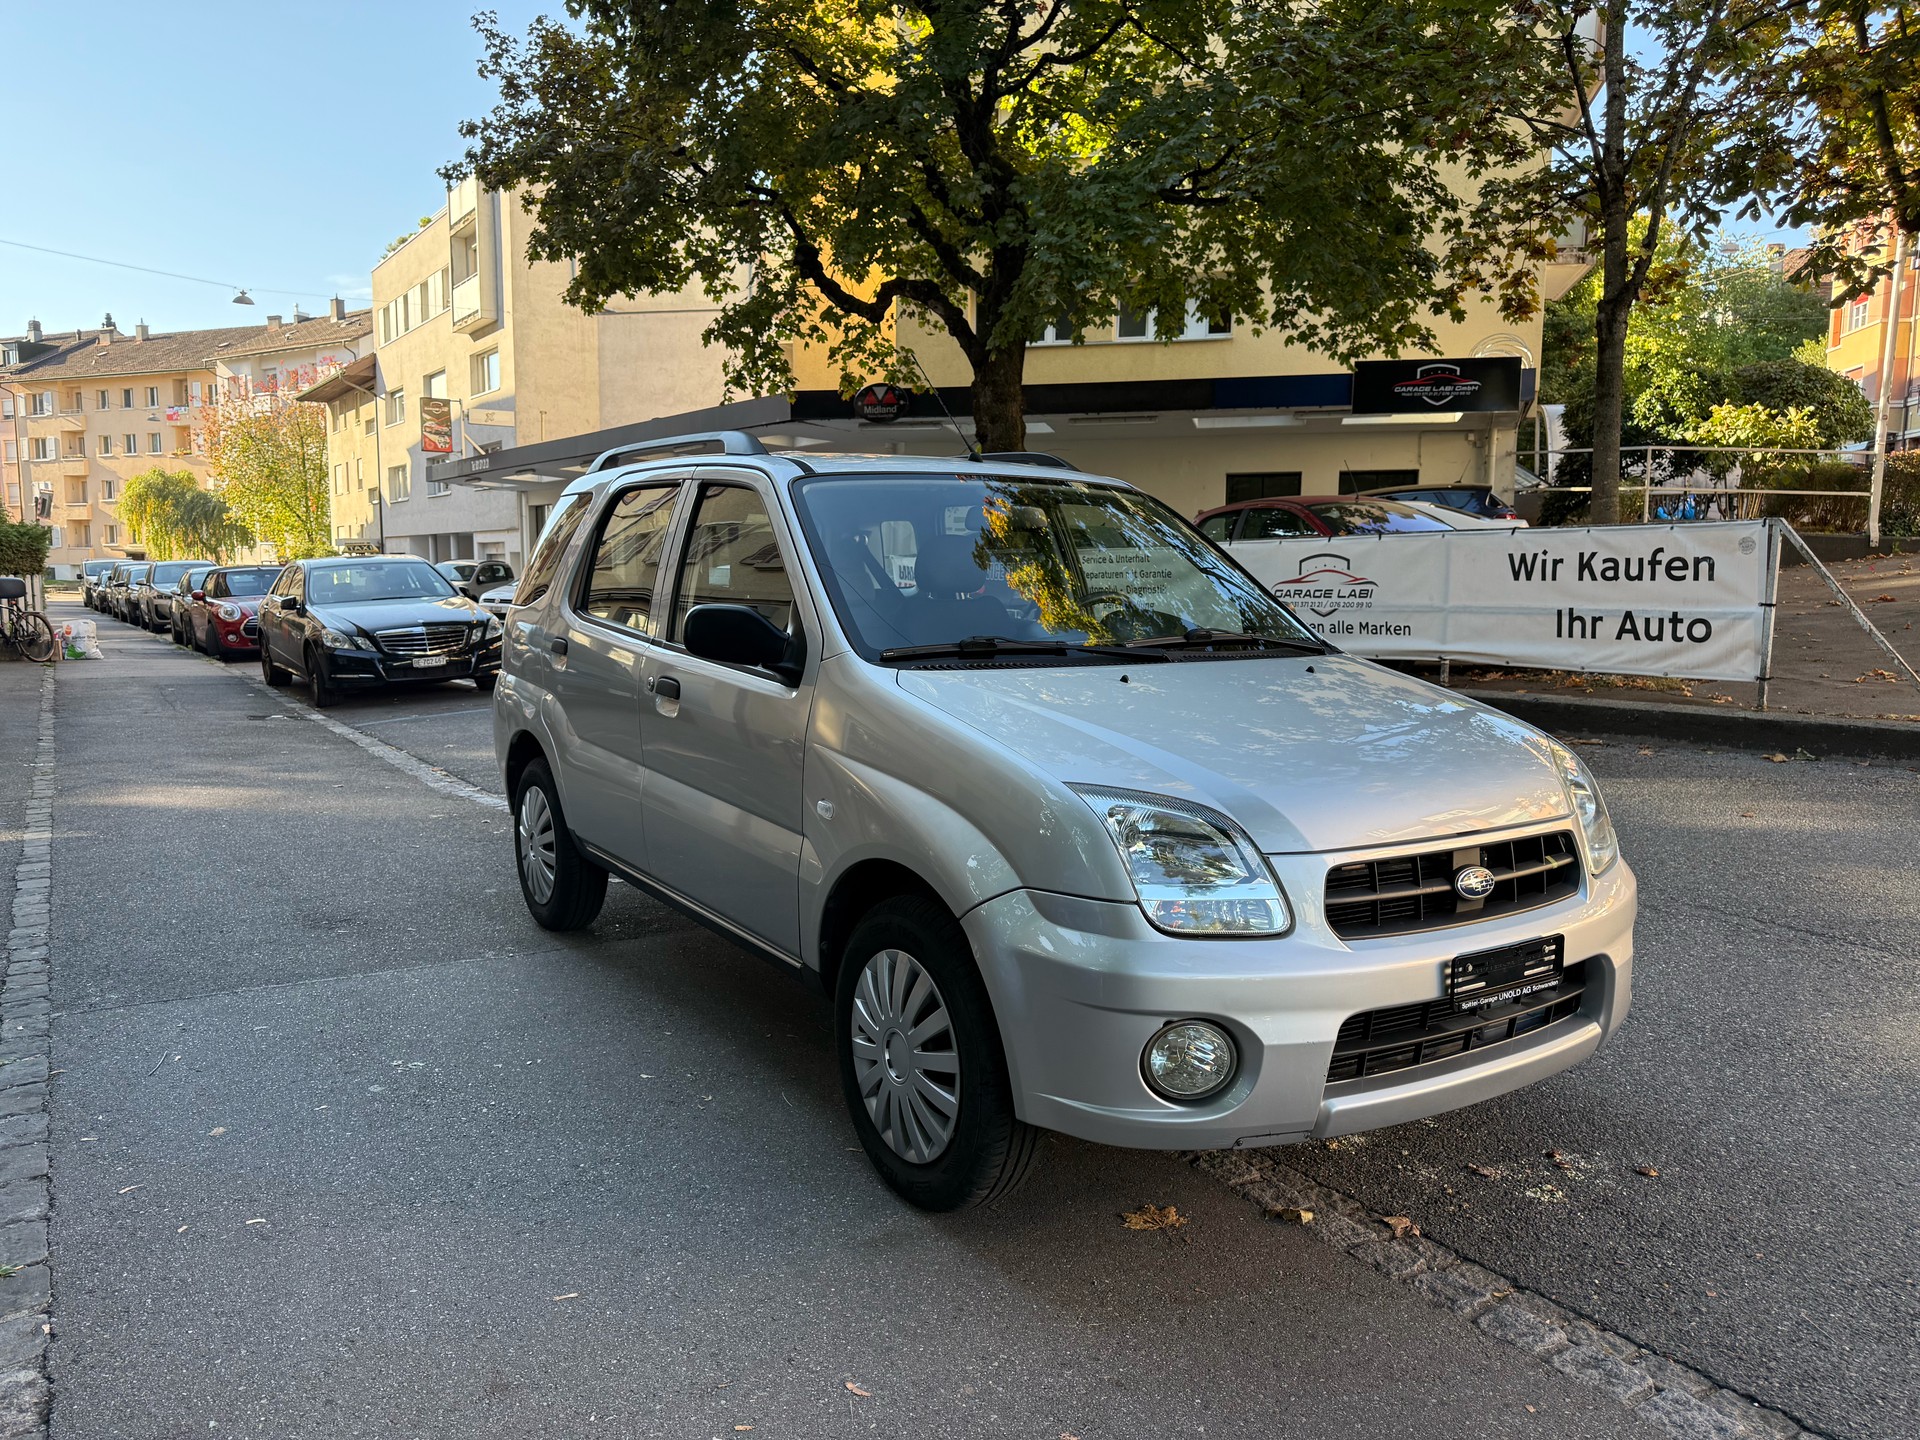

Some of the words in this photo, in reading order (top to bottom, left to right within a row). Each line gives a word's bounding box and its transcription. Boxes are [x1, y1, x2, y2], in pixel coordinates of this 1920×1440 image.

[863, 404, 897, 414] Midland
[1082, 555, 1107, 565] Service
[1108, 555, 1114, 564] &
[1115, 554, 1150, 564] Unterhalt
[1508, 549, 1564, 582] Wir
[1577, 547, 1716, 582] Kaufen
[1084, 570, 1124, 580] eparaturen
[1139, 569, 1172, 579] Garantie
[1126, 585, 1167, 598] Diagnostik
[1274, 588, 1334, 599] GARAGE
[1337, 588, 1374, 599] LABI
[1355, 601, 1364, 609] 99
[1365, 601, 1373, 609] 10
[1329, 620, 1354, 634] alle
[1359, 621, 1411, 636] Marken
[1556, 607, 1603, 640] Ihr
[1615, 610, 1713, 643] Auto
[1461, 995, 1498, 1010] Spittel-Garage
[1498, 988, 1521, 1001] UNOLD
[1521, 986, 1532, 995] AG
[1532, 980, 1559, 992] Schwanden
